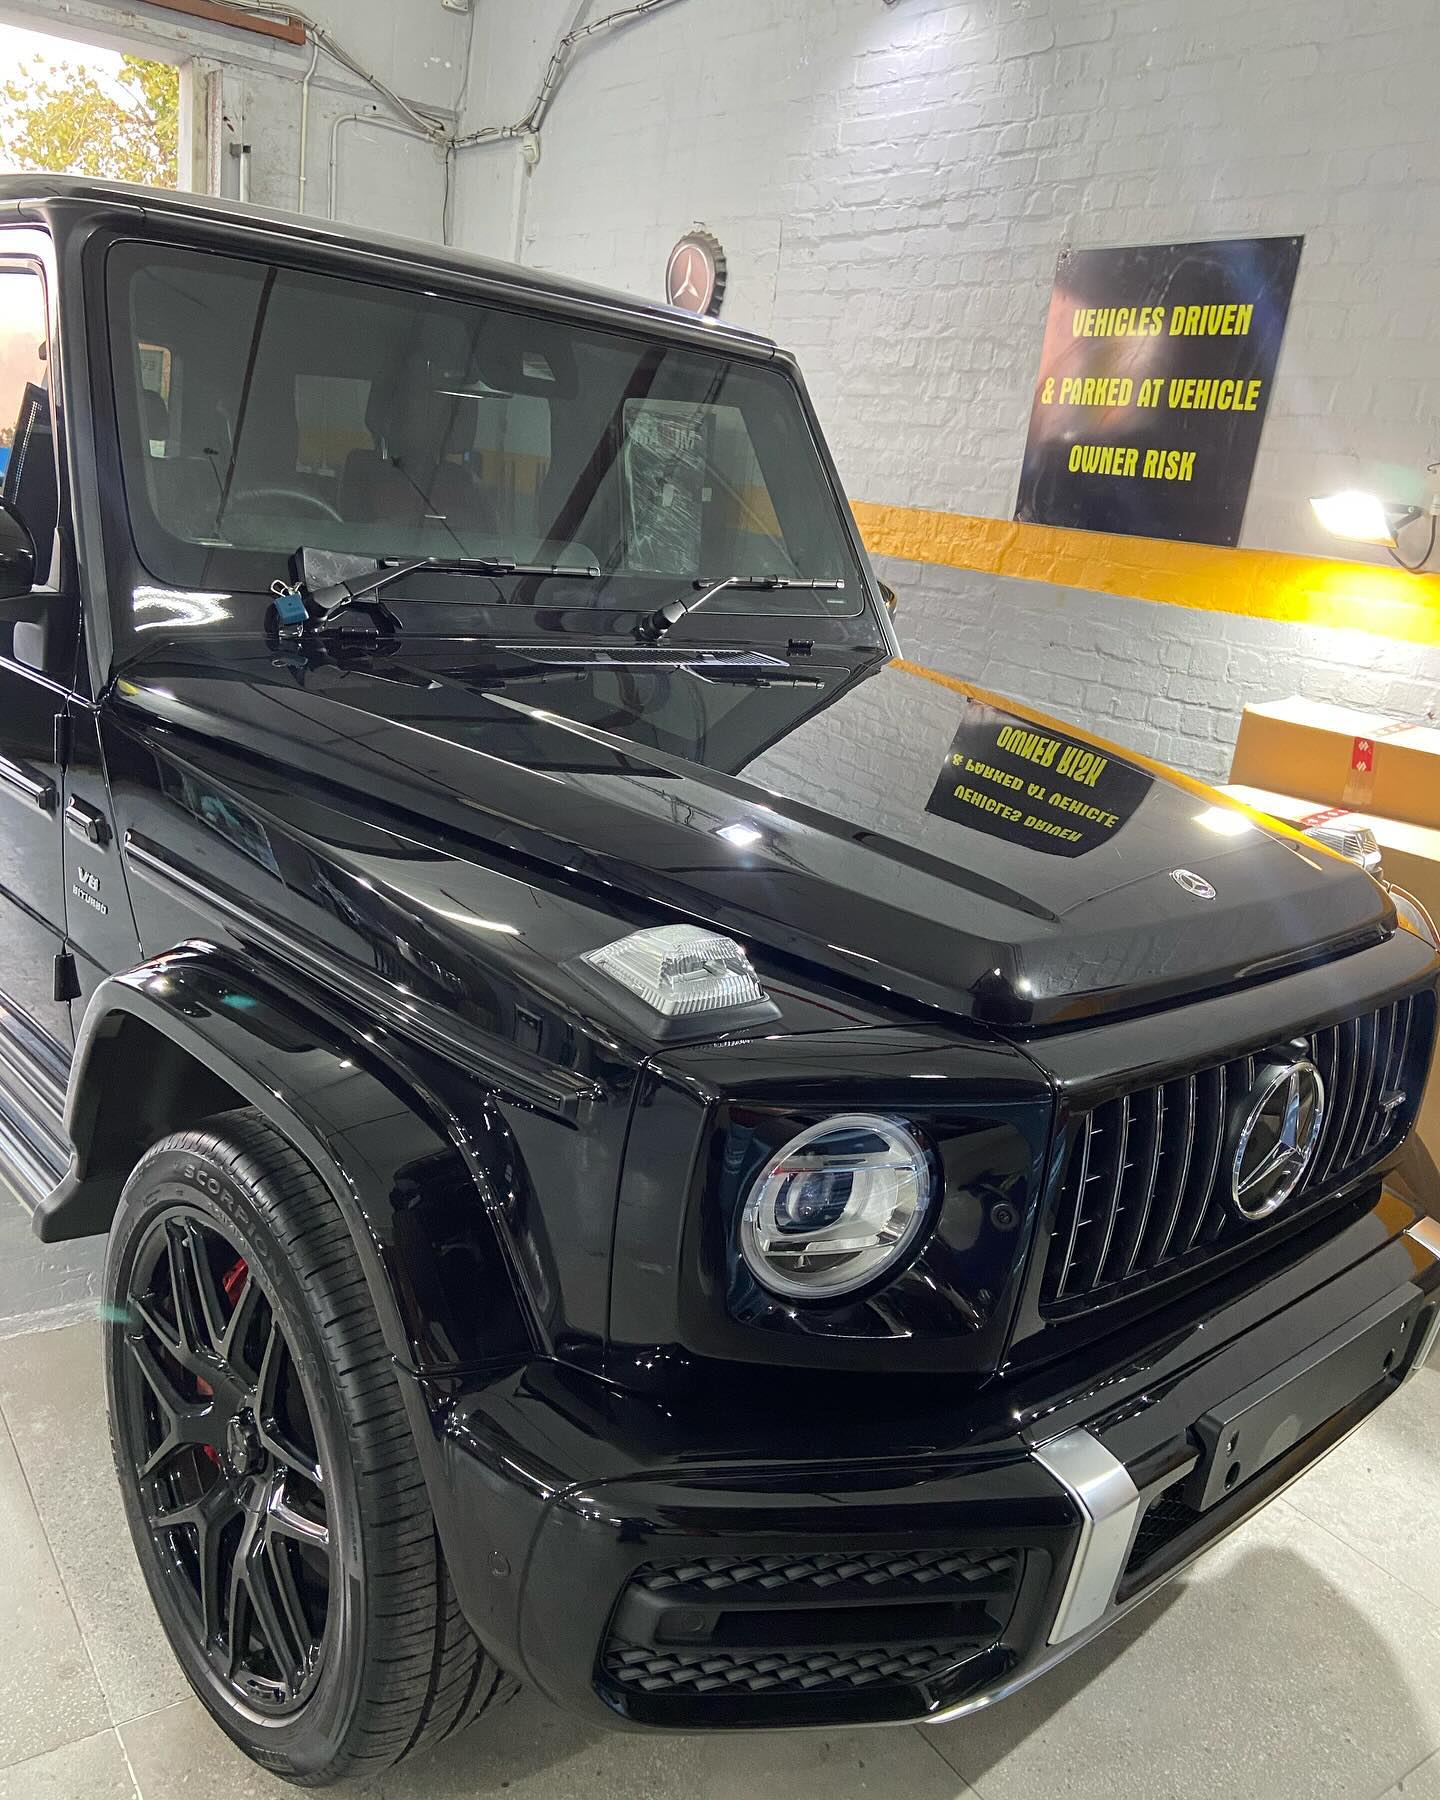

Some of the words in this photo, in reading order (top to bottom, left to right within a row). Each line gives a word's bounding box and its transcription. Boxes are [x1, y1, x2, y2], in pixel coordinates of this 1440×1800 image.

[1072, 306, 1164, 337] VEHICLES
[1169, 304, 1253, 336] DRIVEN
[1041, 377, 1055, 405] &
[1058, 377, 1133, 407] PARKED
[1136, 378, 1163, 408] AT
[1168, 379, 1262, 411] VEHICLE
[1068, 445, 1139, 477] OWNER
[1142, 450, 1196, 481] RISK
[78, 866, 101, 892] V8
